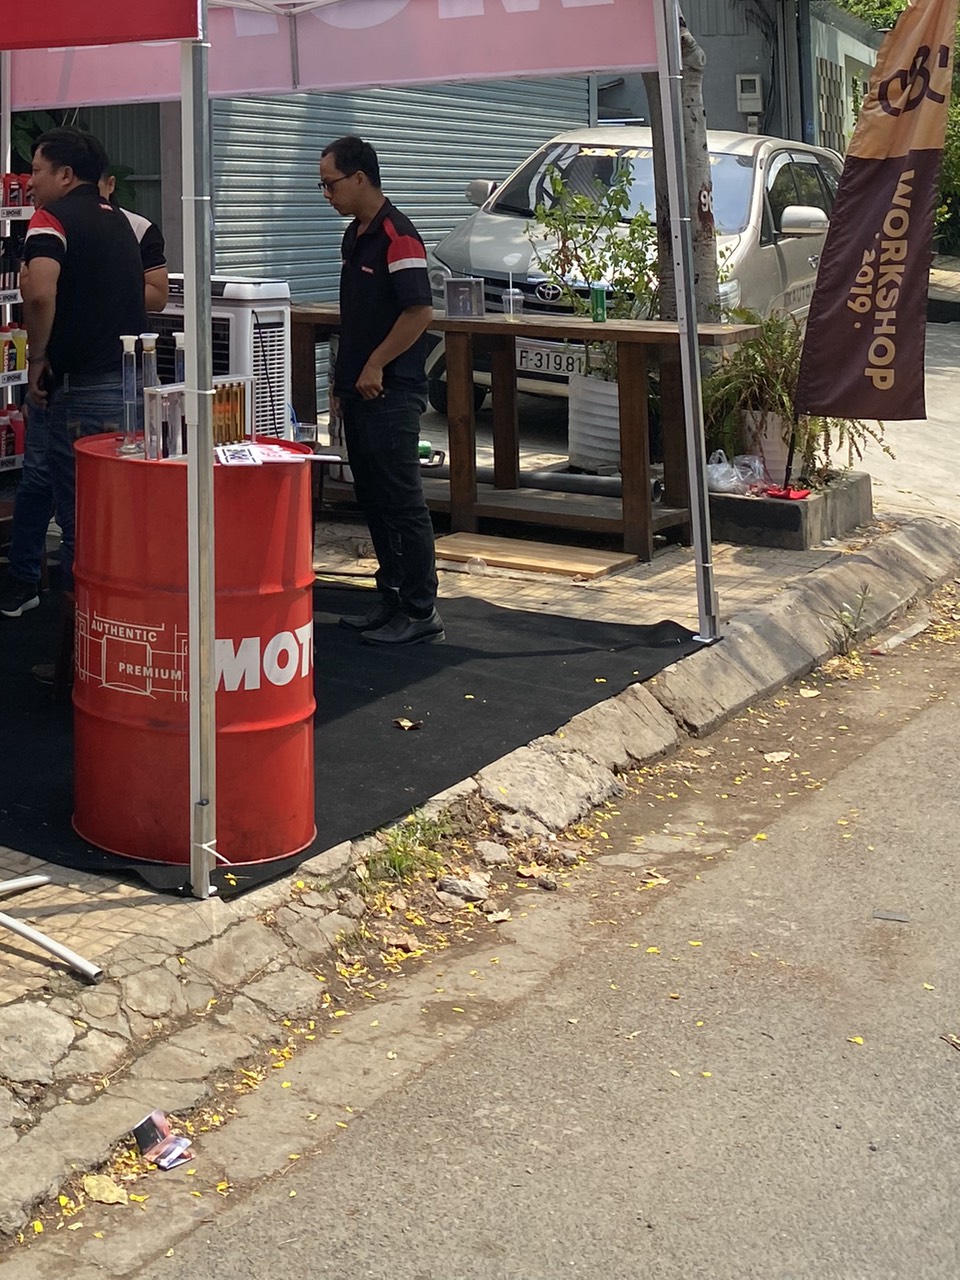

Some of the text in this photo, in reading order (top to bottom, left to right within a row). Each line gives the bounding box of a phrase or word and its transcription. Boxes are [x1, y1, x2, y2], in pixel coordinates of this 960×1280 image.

[865, 170, 915, 390] WORKSHOP
[91, 620, 157, 642] AUTHENTIC
[119, 662, 182, 681] PREMIUM
[215, 619, 313, 692] MOT
